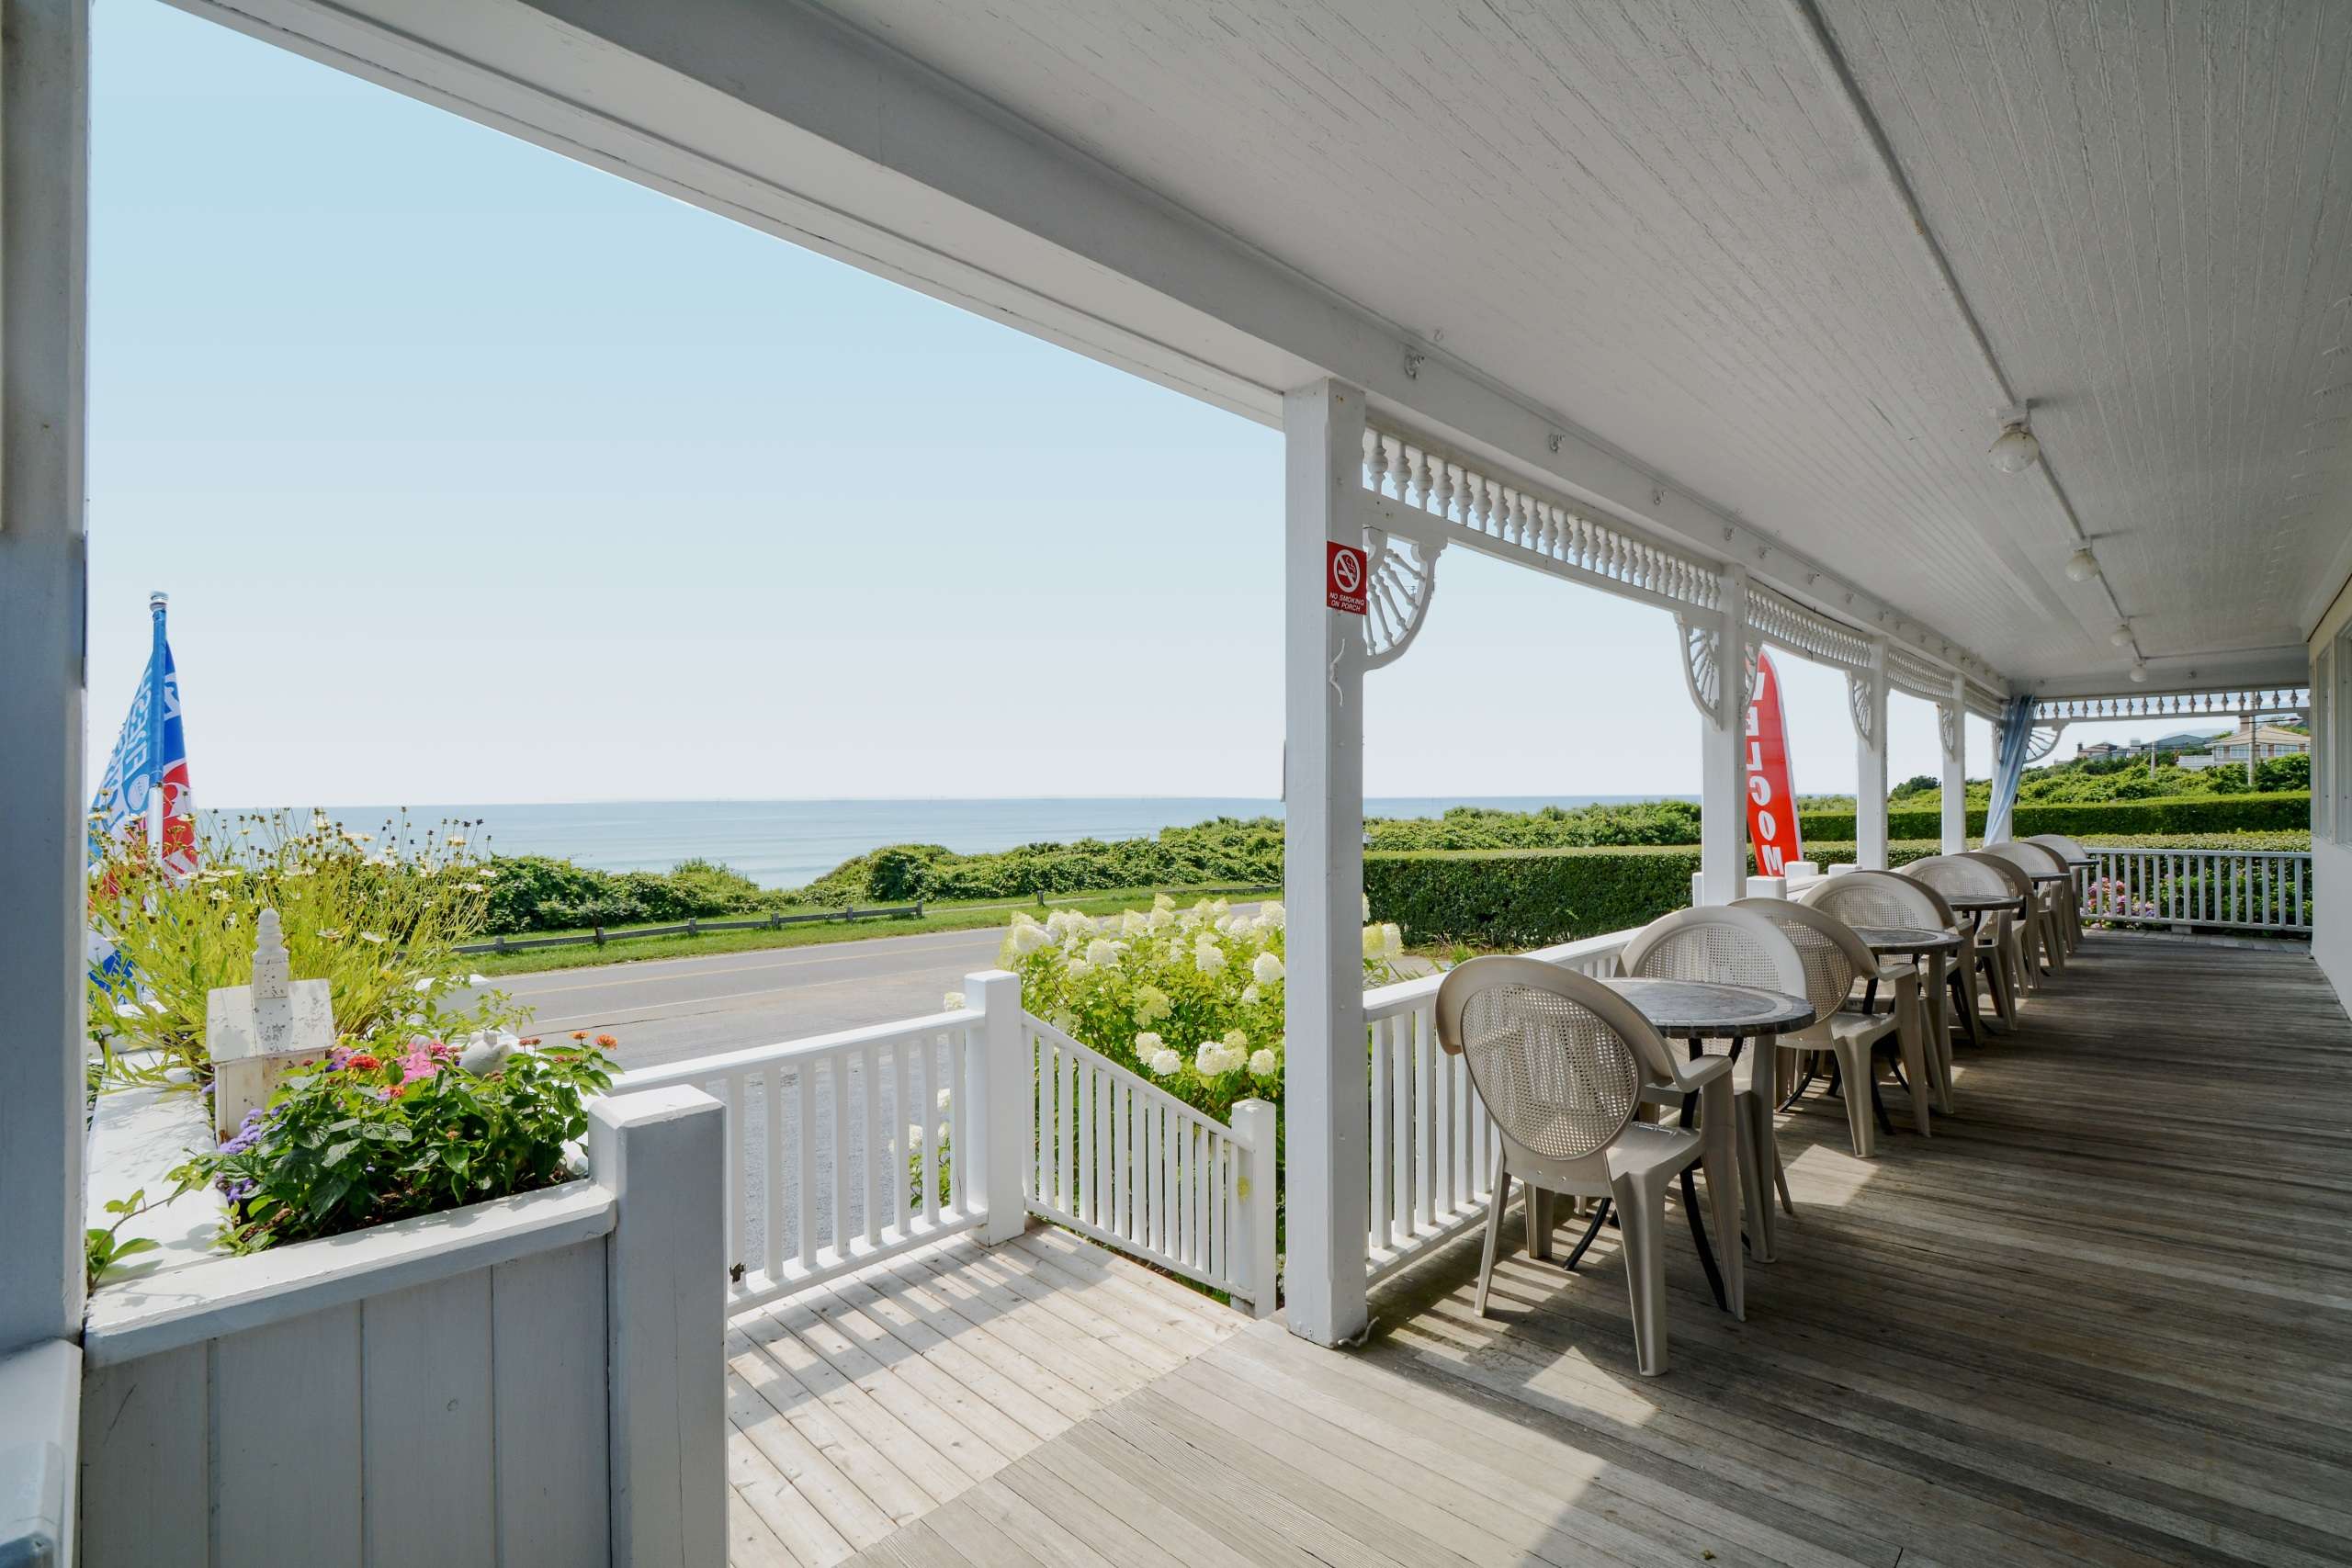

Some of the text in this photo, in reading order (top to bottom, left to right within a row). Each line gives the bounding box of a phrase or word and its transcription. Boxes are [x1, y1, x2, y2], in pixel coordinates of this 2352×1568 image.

[1329, 592, 1364, 606] NO SMOKING
[1331, 600, 1361, 613] ON PORCH
